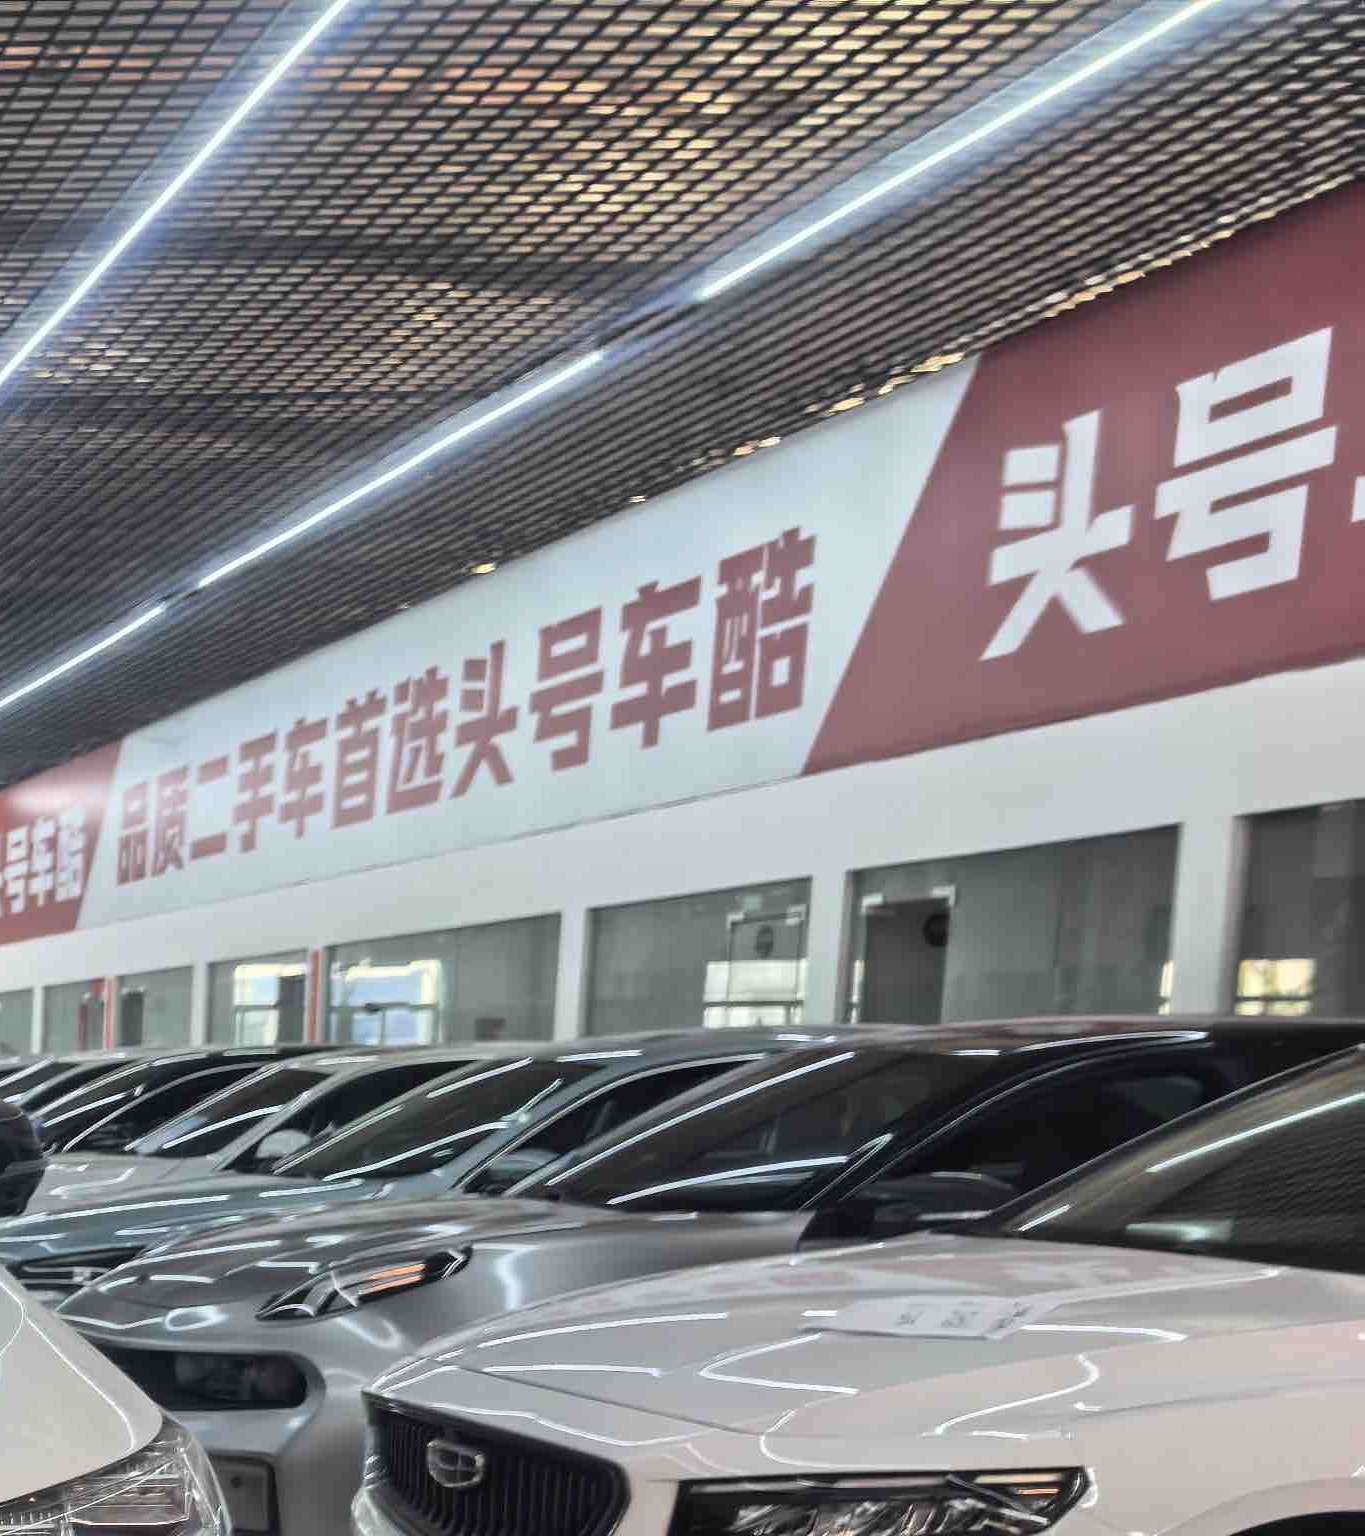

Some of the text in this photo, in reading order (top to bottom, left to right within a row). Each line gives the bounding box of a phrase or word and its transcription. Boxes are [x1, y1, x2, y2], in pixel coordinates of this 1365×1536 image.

[979, 327, 1365, 662] 头号
[116, 525, 817, 888] 品质二手车首选头号车酷
